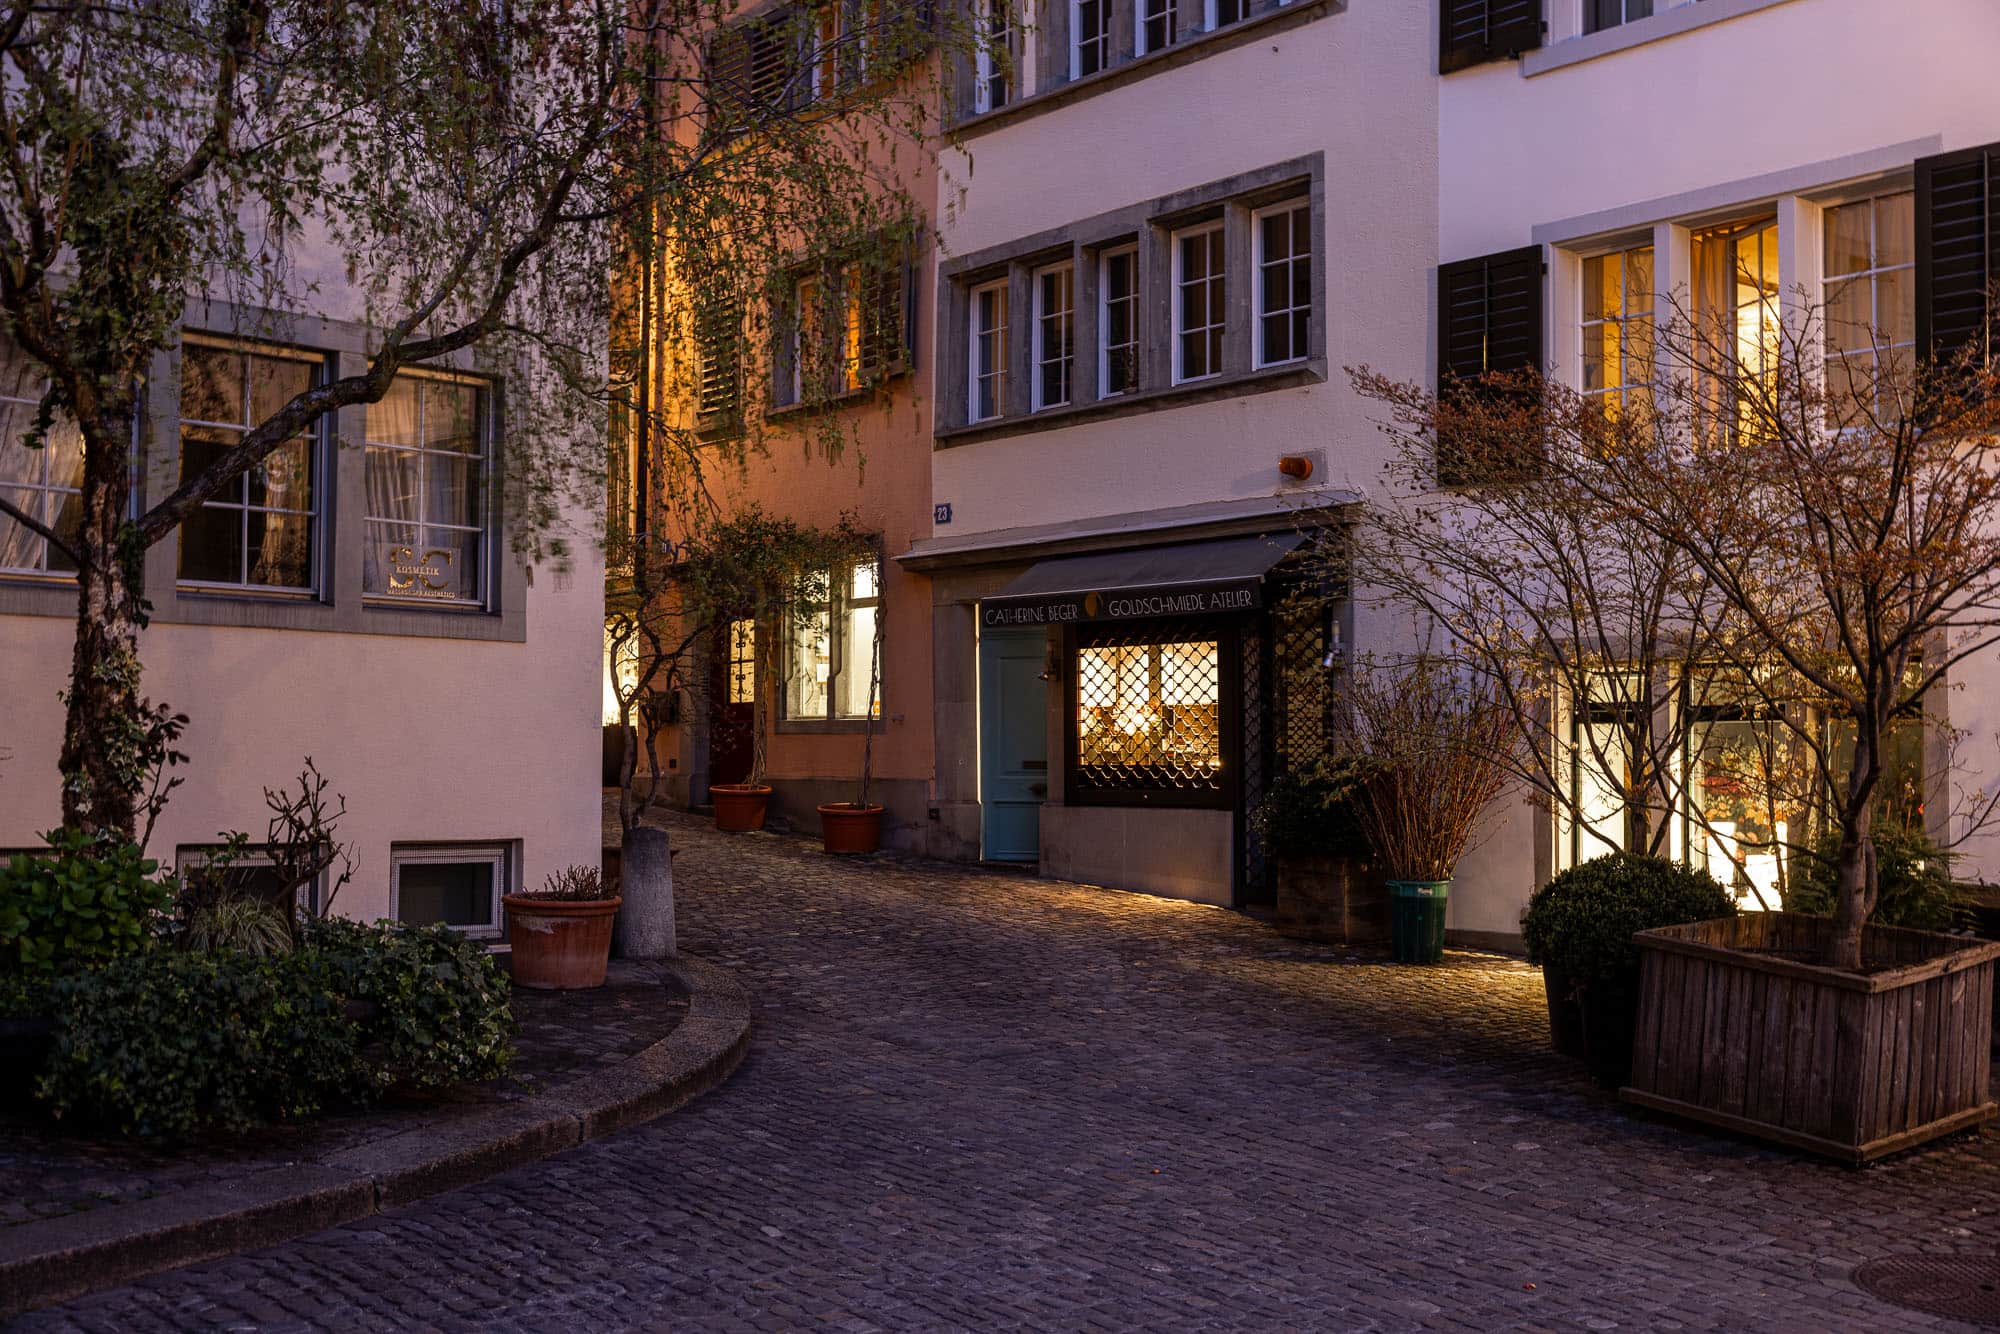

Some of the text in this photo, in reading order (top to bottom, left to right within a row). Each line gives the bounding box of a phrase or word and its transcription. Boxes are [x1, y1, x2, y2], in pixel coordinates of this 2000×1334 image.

[937, 506, 948, 521] 23
[396, 566, 439, 576] KOSMETIK
[985, 590, 1253, 625] CATHERINE BEGER GOLDSCHMIEDE ATELIER
